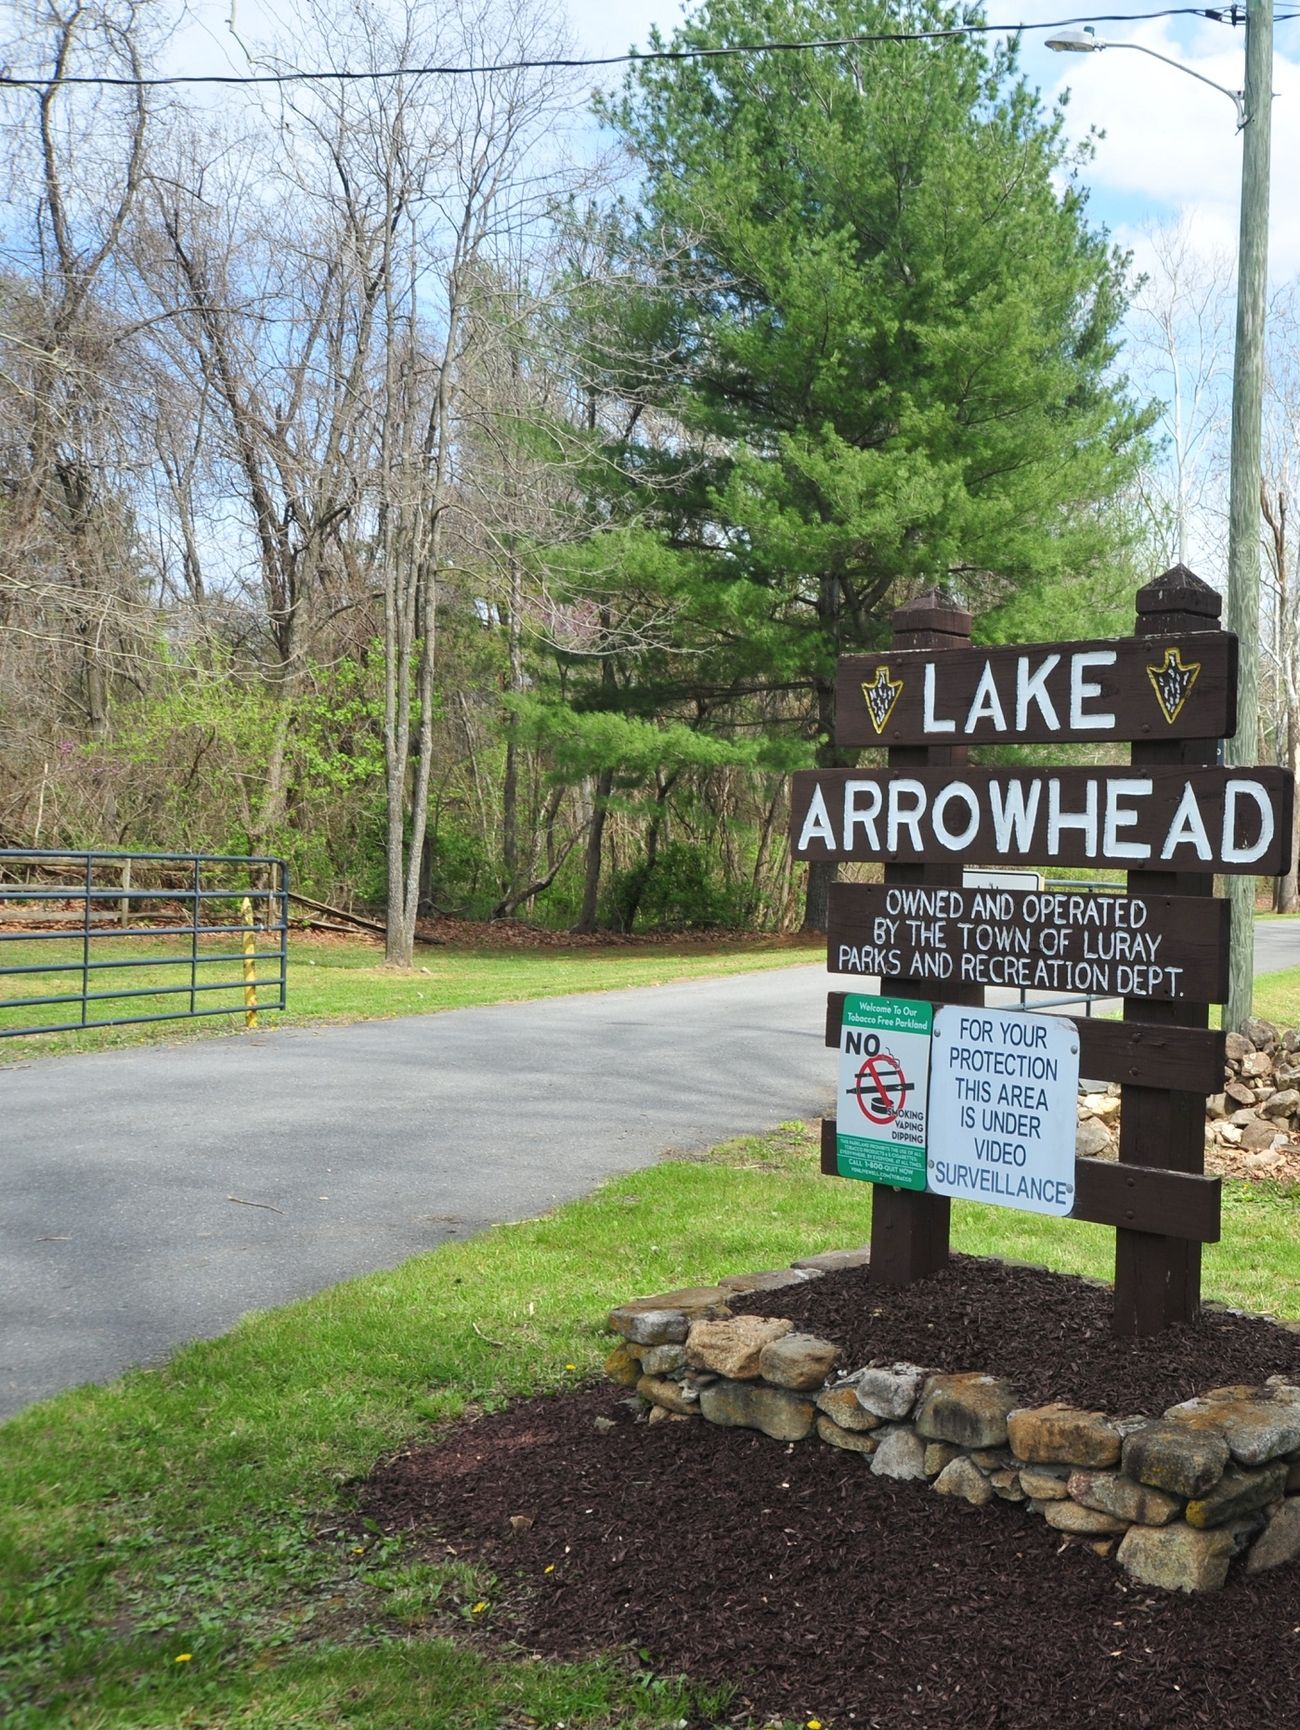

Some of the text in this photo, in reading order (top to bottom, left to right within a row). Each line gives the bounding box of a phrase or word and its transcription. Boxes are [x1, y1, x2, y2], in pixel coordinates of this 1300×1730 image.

[923, 650, 1118, 734] LAKE
[797, 778, 1275, 864] ARROWHEAD
[886, 888, 1147, 929] OWNED AND OPERATED
[873, 917, 1162, 961] BY THE TOWN OF LURAY
[838, 945, 1184, 998] PARKS AND RECREATION DEPT.
[847, 1012, 928, 1030] Tobacco Free Parkland
[859, 1002, 918, 1016] Welcome To Our
[845, 1031, 881, 1057] NO
[960, 1018, 1047, 1049] FOR YOUR
[950, 1047, 1058, 1082] PROTECTION
[955, 1077, 1049, 1111] THIS AREA
[887, 1107, 924, 1121] SMOKING
[895, 1120, 924, 1132] VAPING
[960, 1106, 1041, 1139] IS UNDER
[892, 1131, 924, 1144] DIPPING
[974, 1137, 1027, 1167] VIDEO
[848, 1158, 862, 1167] CALL
[865, 1161, 898, 1172] 1-800-QUIT
[935, 1160, 1067, 1205] SURVEILLANCE
